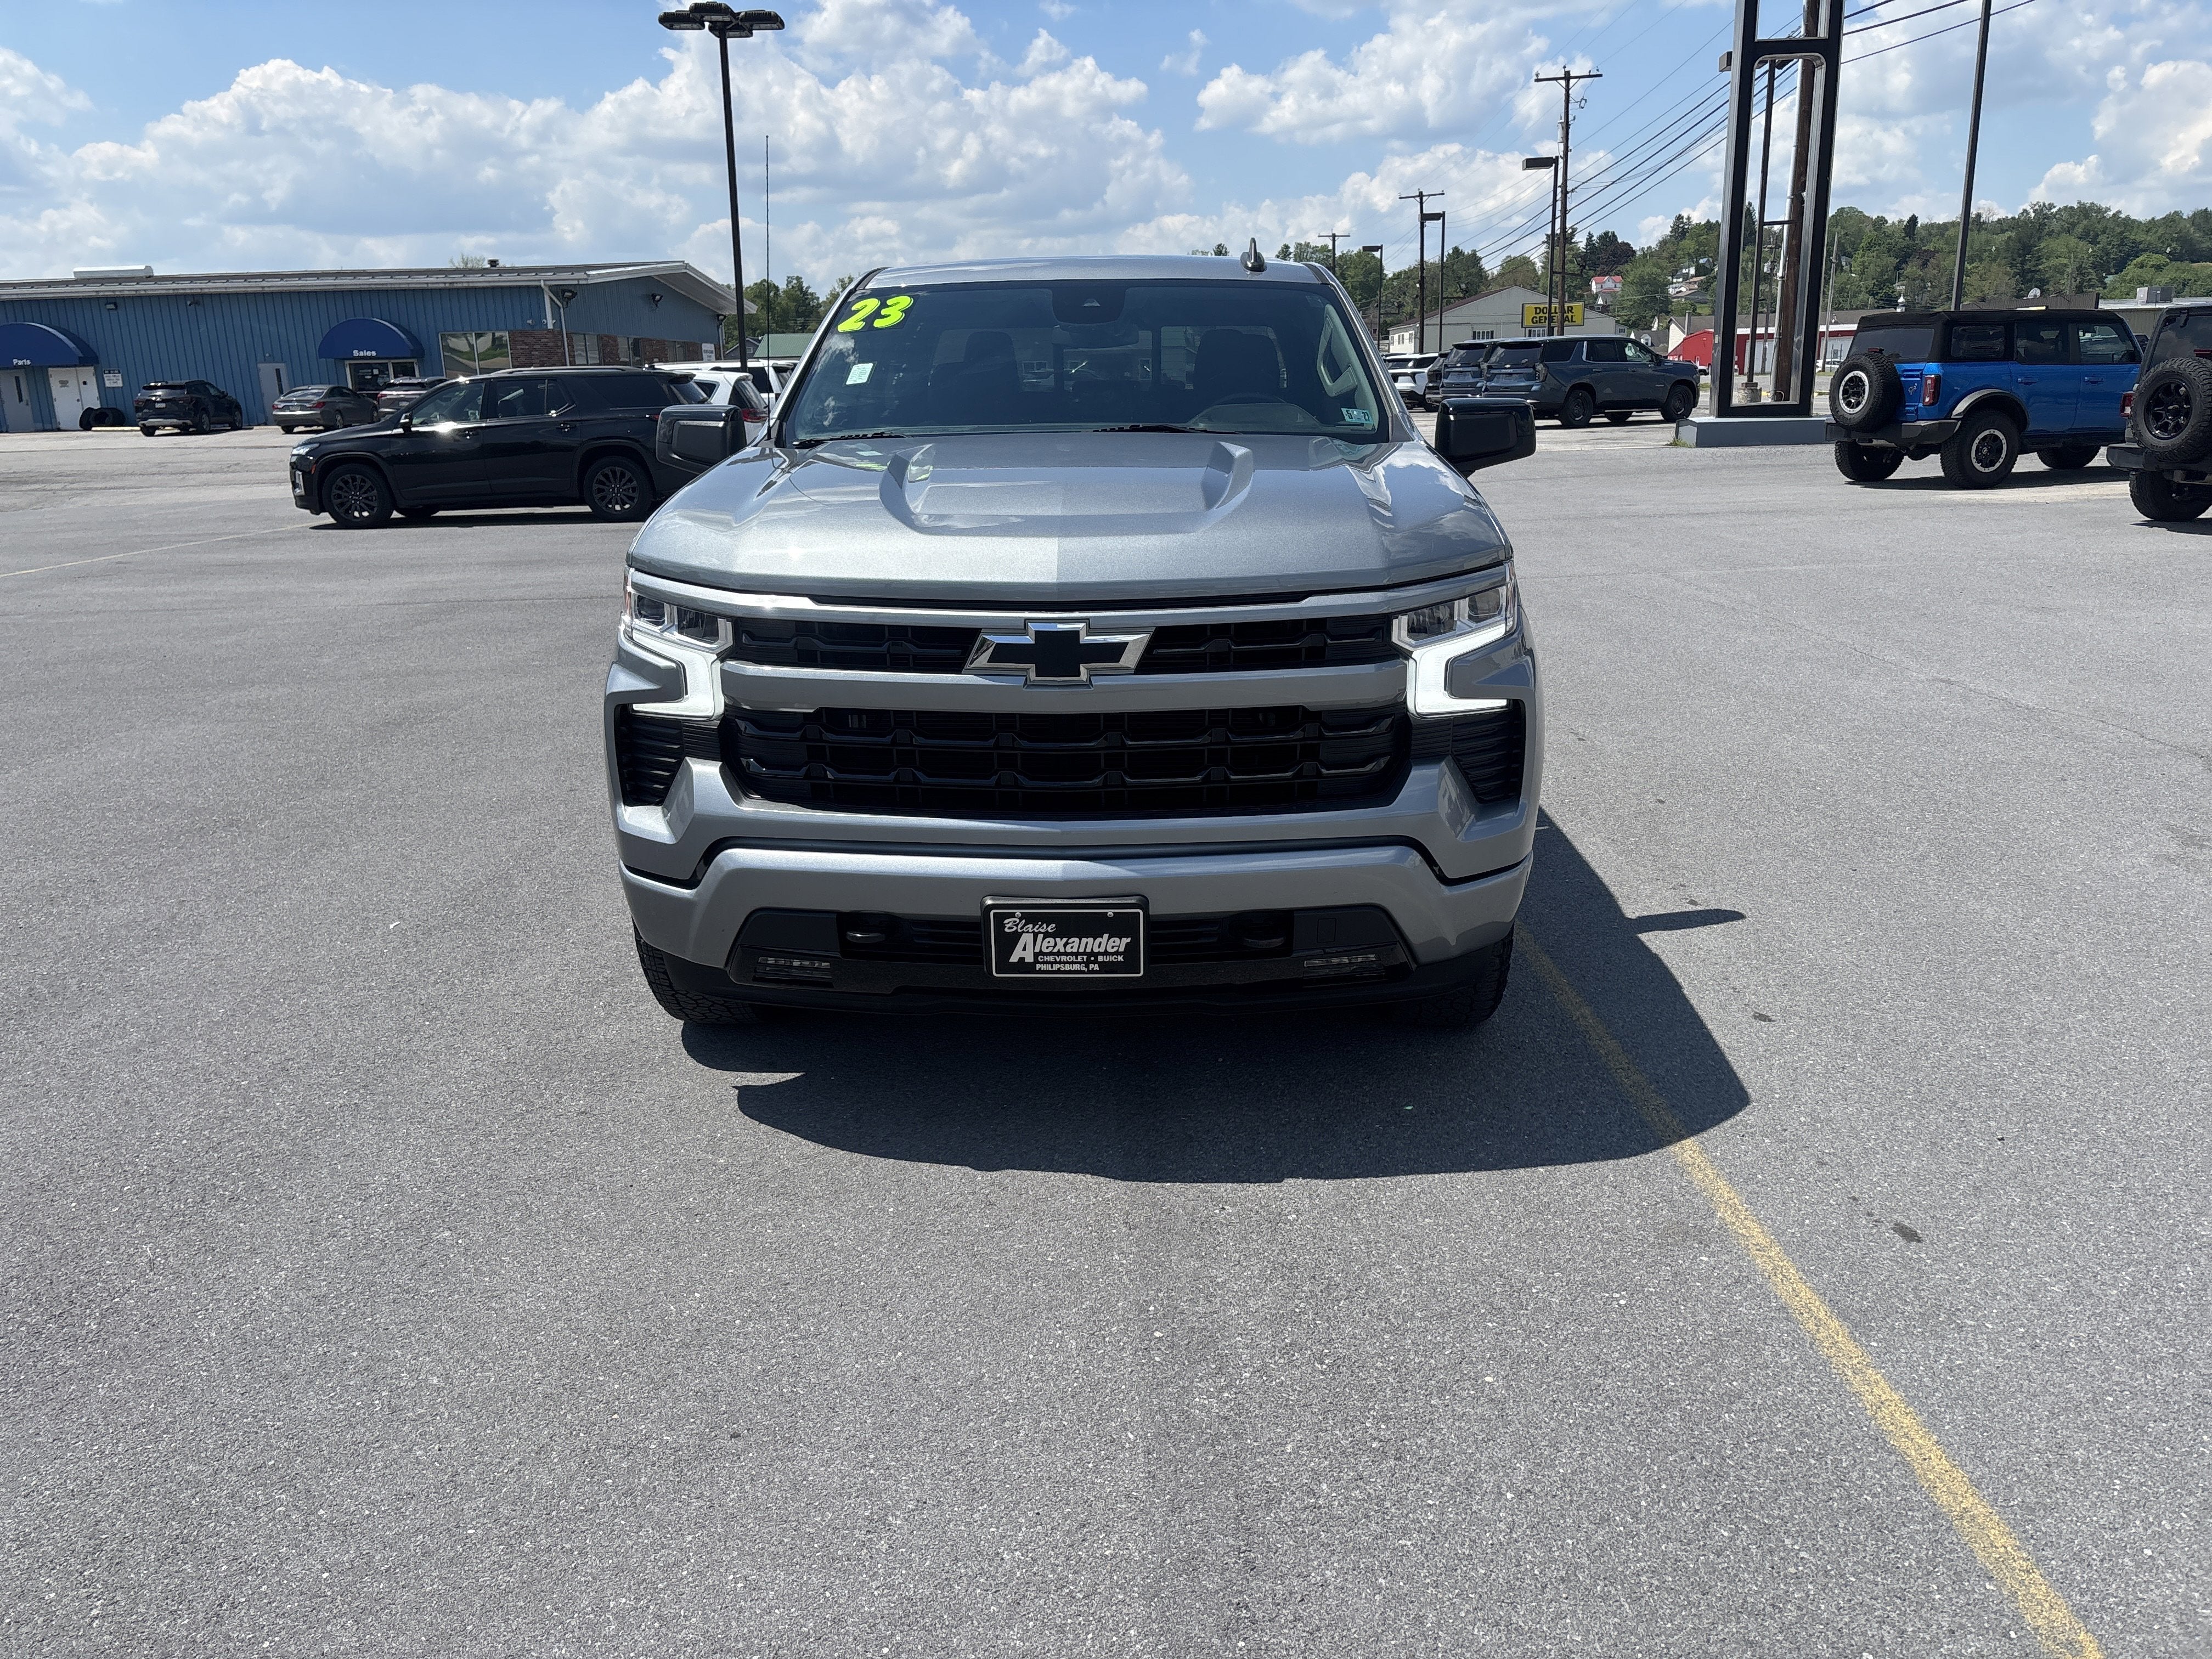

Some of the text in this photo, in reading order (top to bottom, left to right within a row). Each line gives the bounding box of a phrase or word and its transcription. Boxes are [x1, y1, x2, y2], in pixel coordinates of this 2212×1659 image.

[837, 296, 914, 332] 23
[1531, 314, 1576, 324] GENEAL
[1346, 409, 1353, 420] 5
[1003, 918, 1057, 933] Blaise
[1009, 933, 1131, 962] Alexander
[1036, 963, 1087, 972] PHILIPSBURG,
